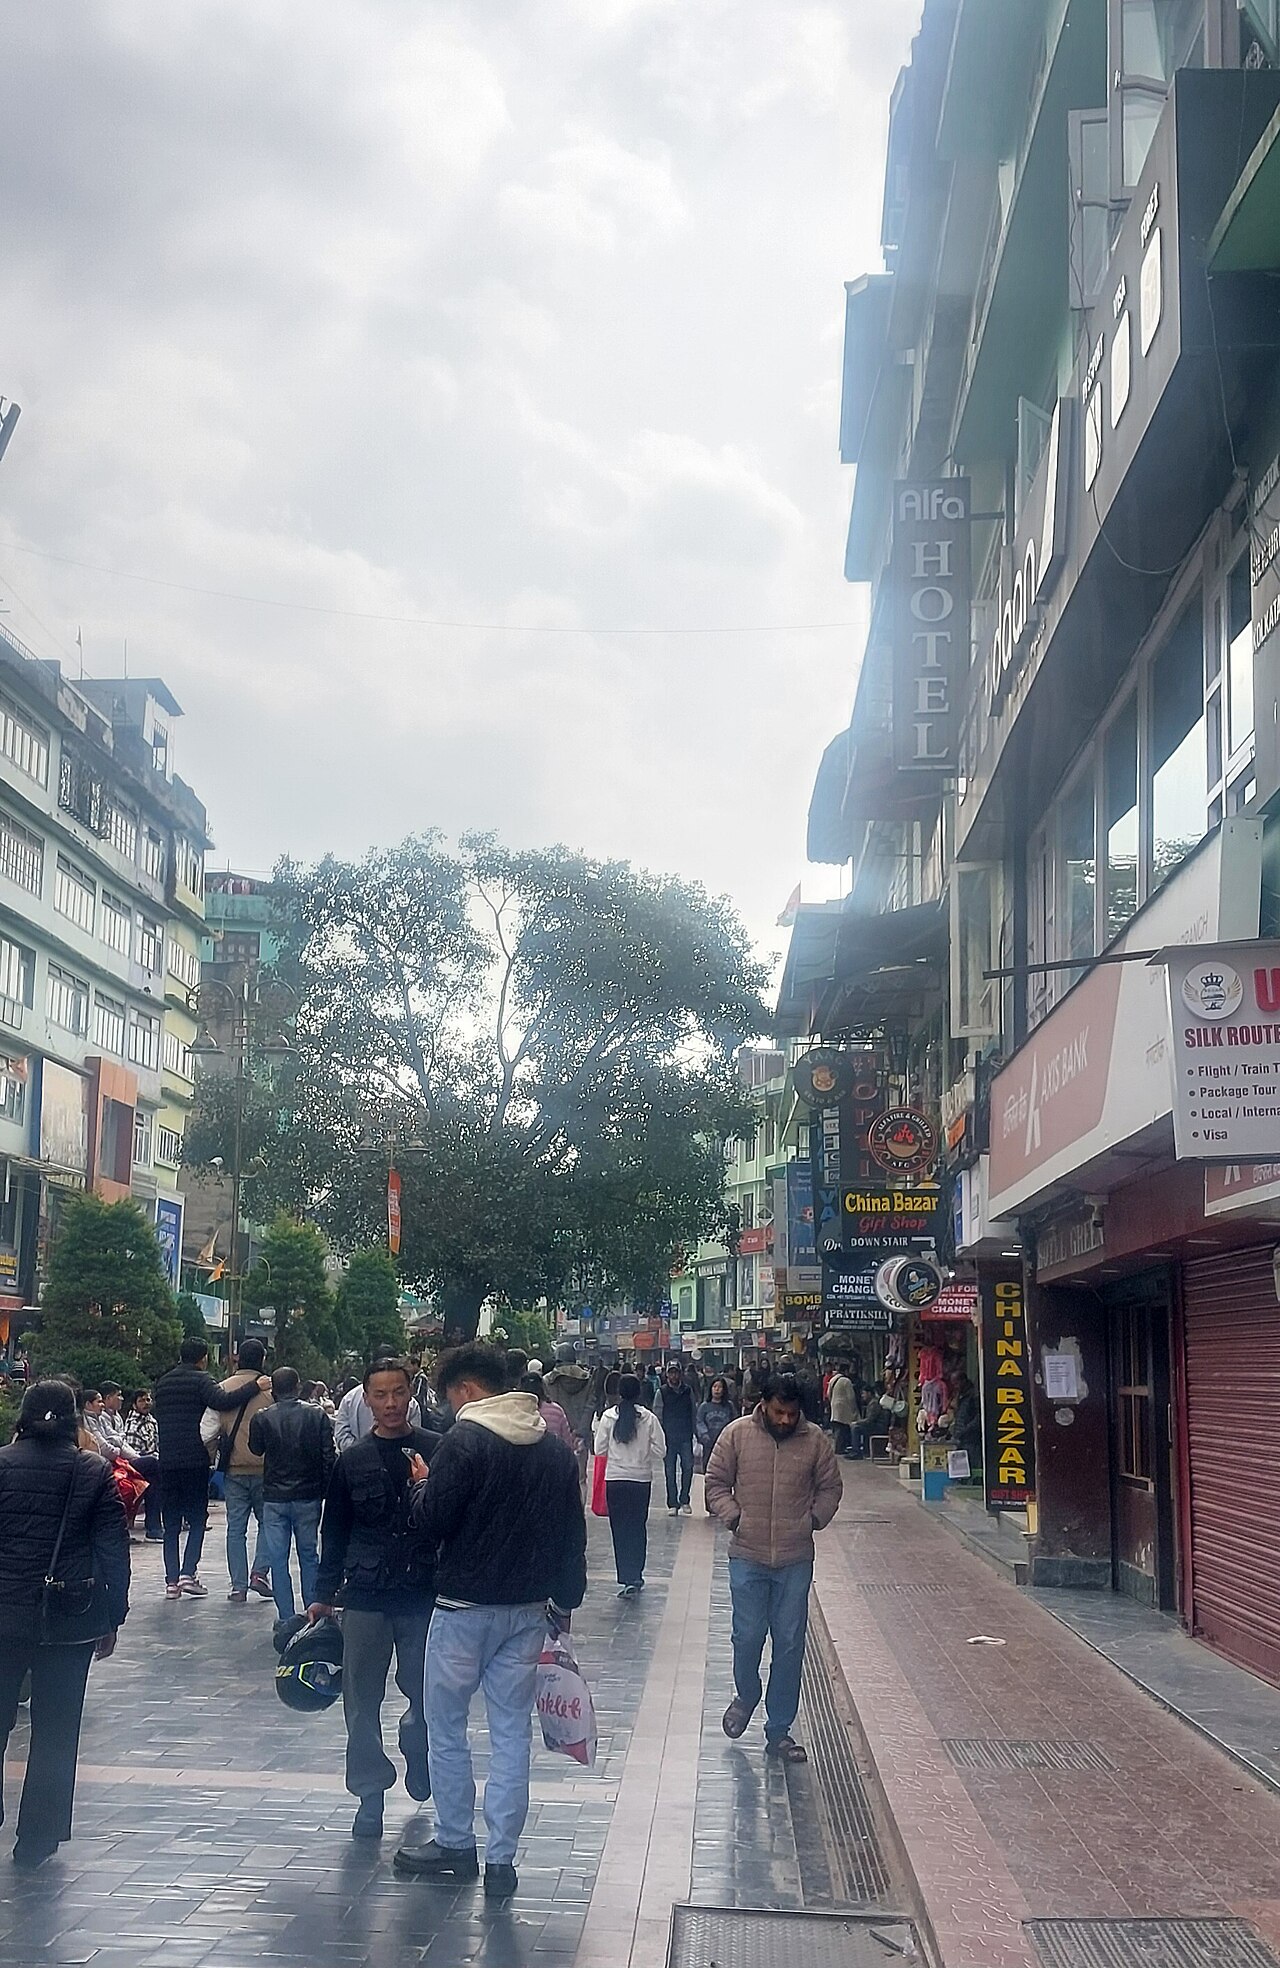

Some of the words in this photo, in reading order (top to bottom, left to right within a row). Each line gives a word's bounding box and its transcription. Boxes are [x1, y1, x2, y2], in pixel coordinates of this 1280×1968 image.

[1113, 273, 1127, 320] VISA
[900, 488, 966, 523] Alfa
[910, 538, 954, 761] HOTEL
[1184, 1026, 1224, 1049] SILK
[1226, 1024, 1280, 1046] ROUTE
[1040, 1053, 1061, 1107] AXIS
[1061, 1024, 1090, 1088] BANK
[1198, 1065, 1231, 1079] Flight
[1240, 1062, 1270, 1076] Train
[1199, 1084, 1249, 1099] Package
[1252, 1083, 1277, 1096] Tour
[1201, 1105, 1232, 1120] Local
[1203, 1128, 1229, 1141] Visa
[845, 1192, 891, 1213] China
[893, 1191, 939, 1212] Bazar
[859, 1215, 885, 1233] Gift
[890, 1217, 927, 1231] Shop
[851, 1237, 880, 1247] DOWN
[884, 1236, 909, 1247] STAIR
[785, 1295, 822, 1305] BOMB
[931, 1306, 972, 1314] CHANG
[995, 1281, 1023, 1377] CHINA
[996, 1387, 1026, 1485] BAZAR
